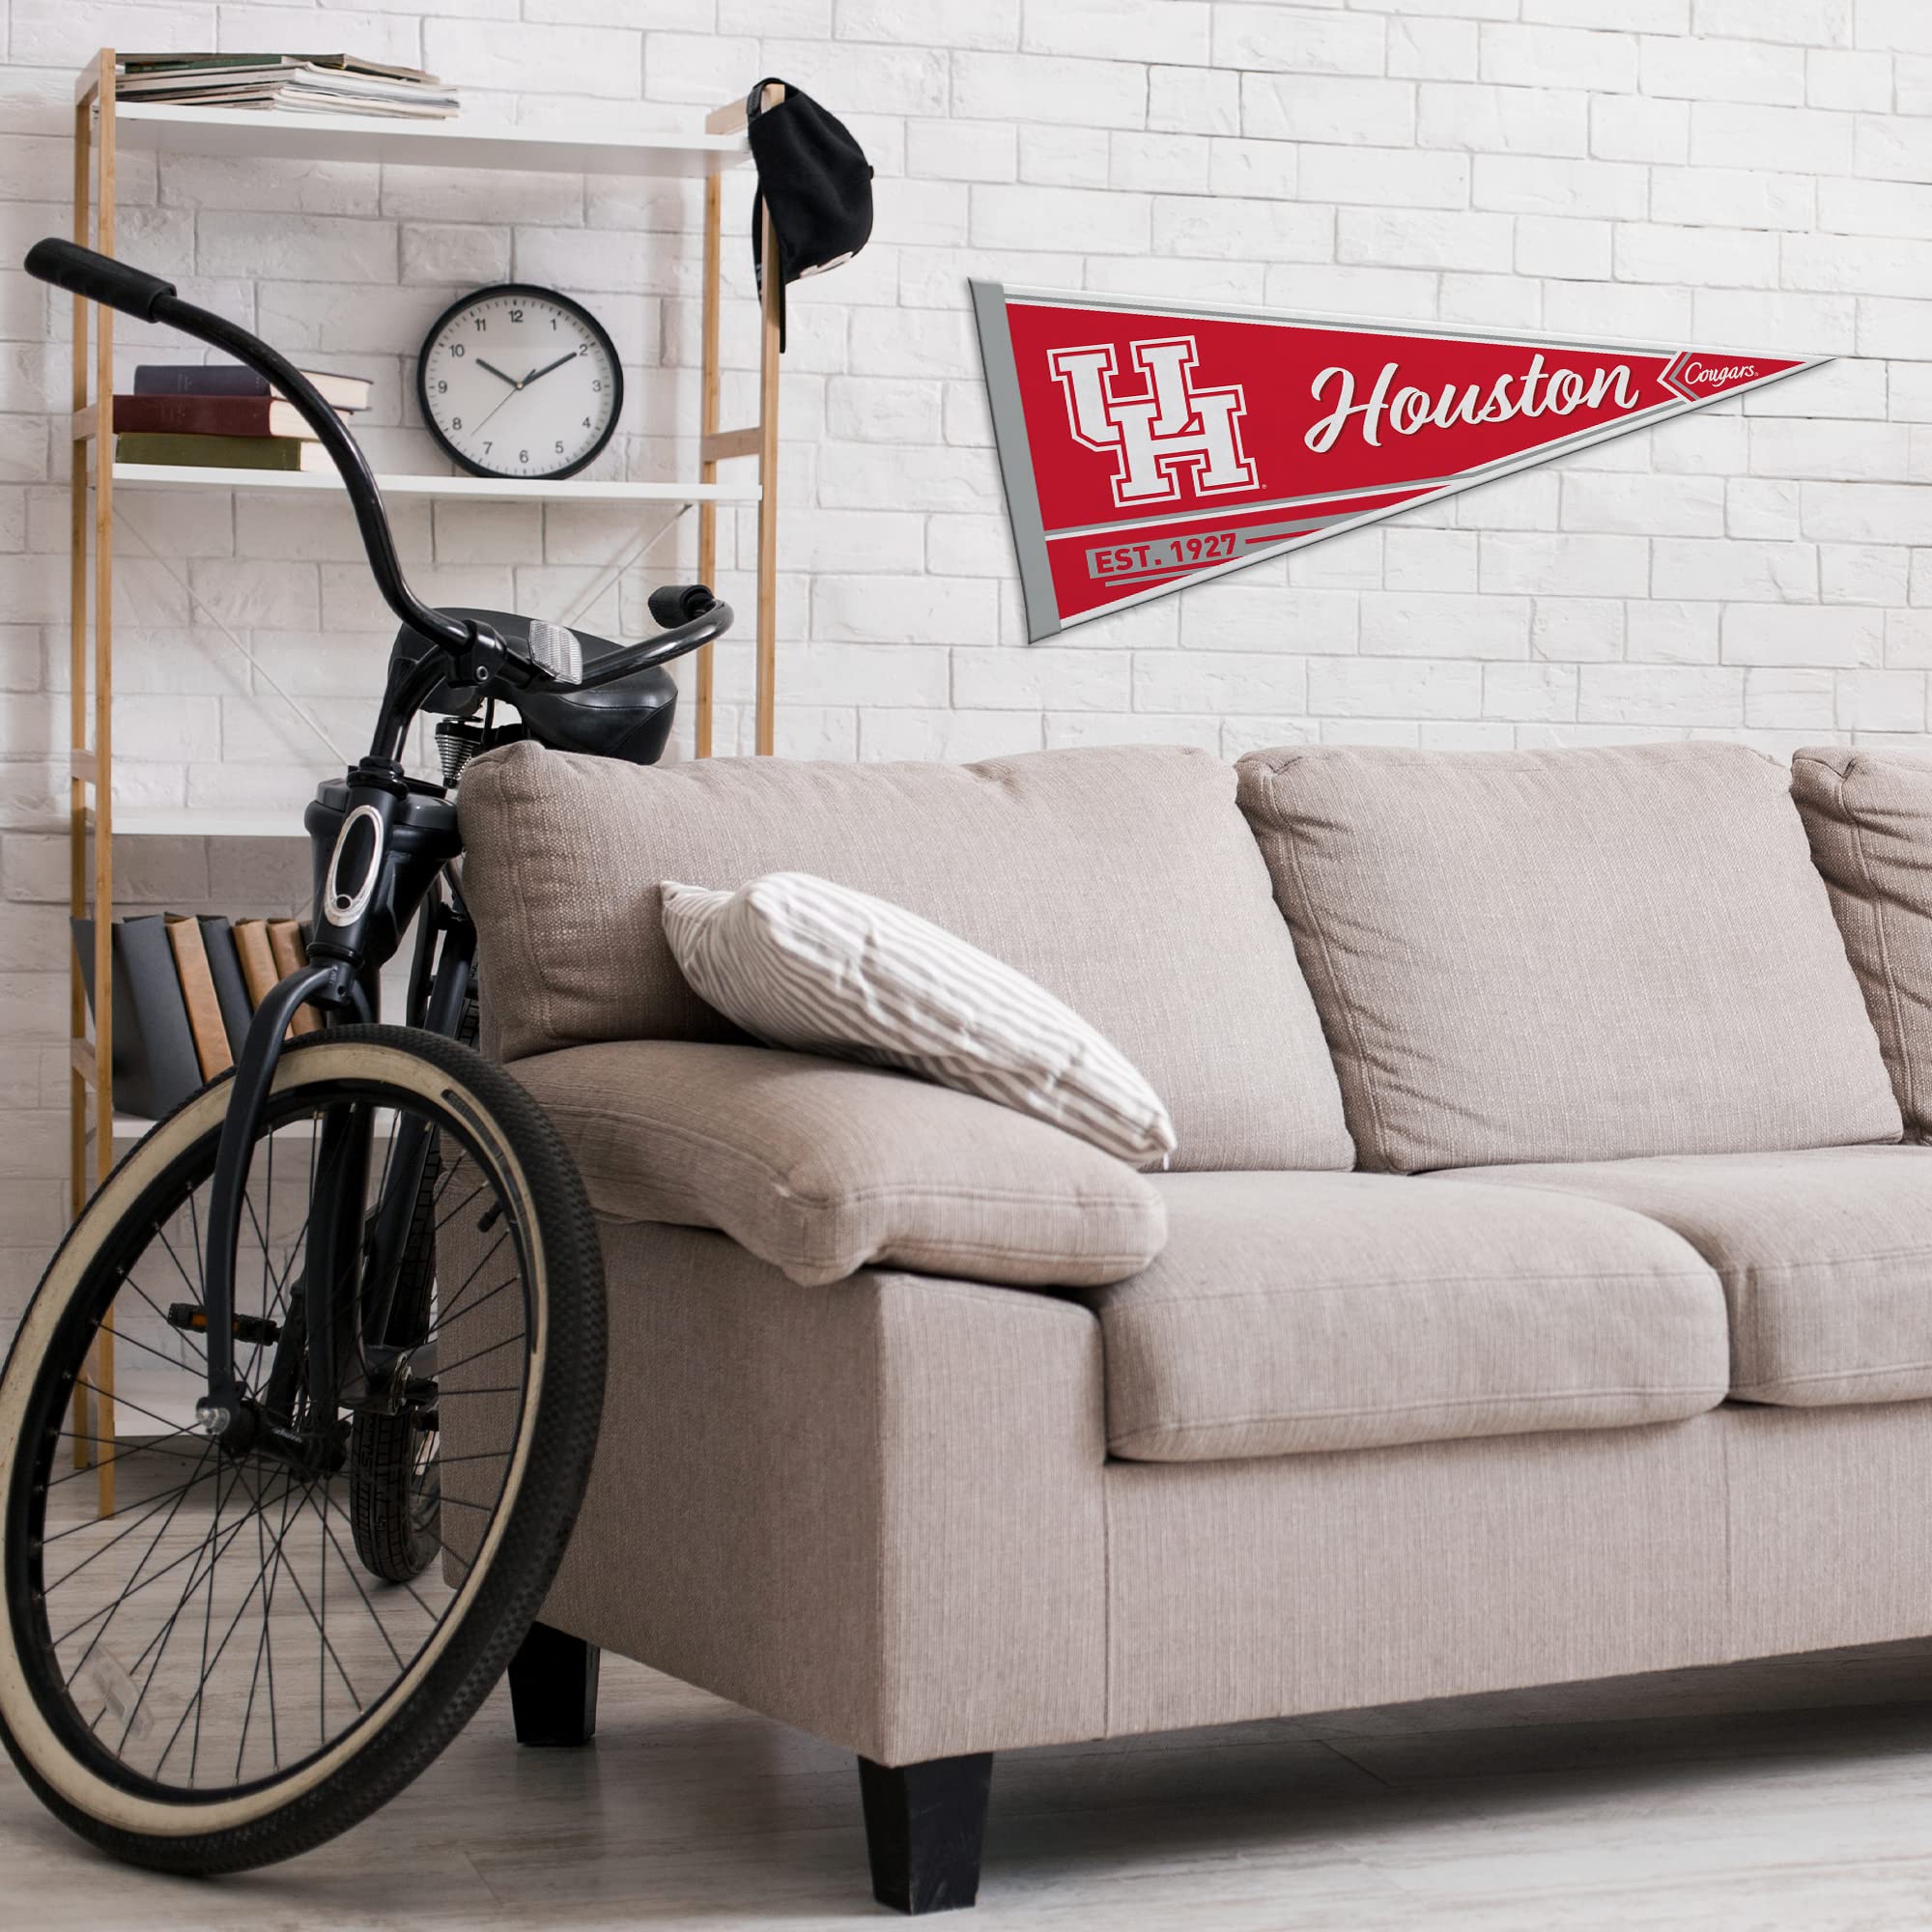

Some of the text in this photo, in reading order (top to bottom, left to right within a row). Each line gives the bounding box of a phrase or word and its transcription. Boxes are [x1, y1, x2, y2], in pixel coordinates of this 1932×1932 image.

[507, 309, 524, 324] 12
[473, 318, 486, 331] 11
[550, 318, 557, 331] 1
[448, 343, 466, 357] 10
[579, 342, 588, 356] 2
[1685, 361, 1755, 387] Cougars
[437, 380, 448, 394] 9
[591, 379, 602, 392] 3
[1304, 354, 1639, 453] Houston
[451, 416, 463, 431] 8
[582, 415, 591, 429] 4
[483, 440, 494, 455] 7
[554, 440, 565, 454] 5
[519, 449, 529, 464] 6
[1094, 532, 1236, 574] EST. 1927
